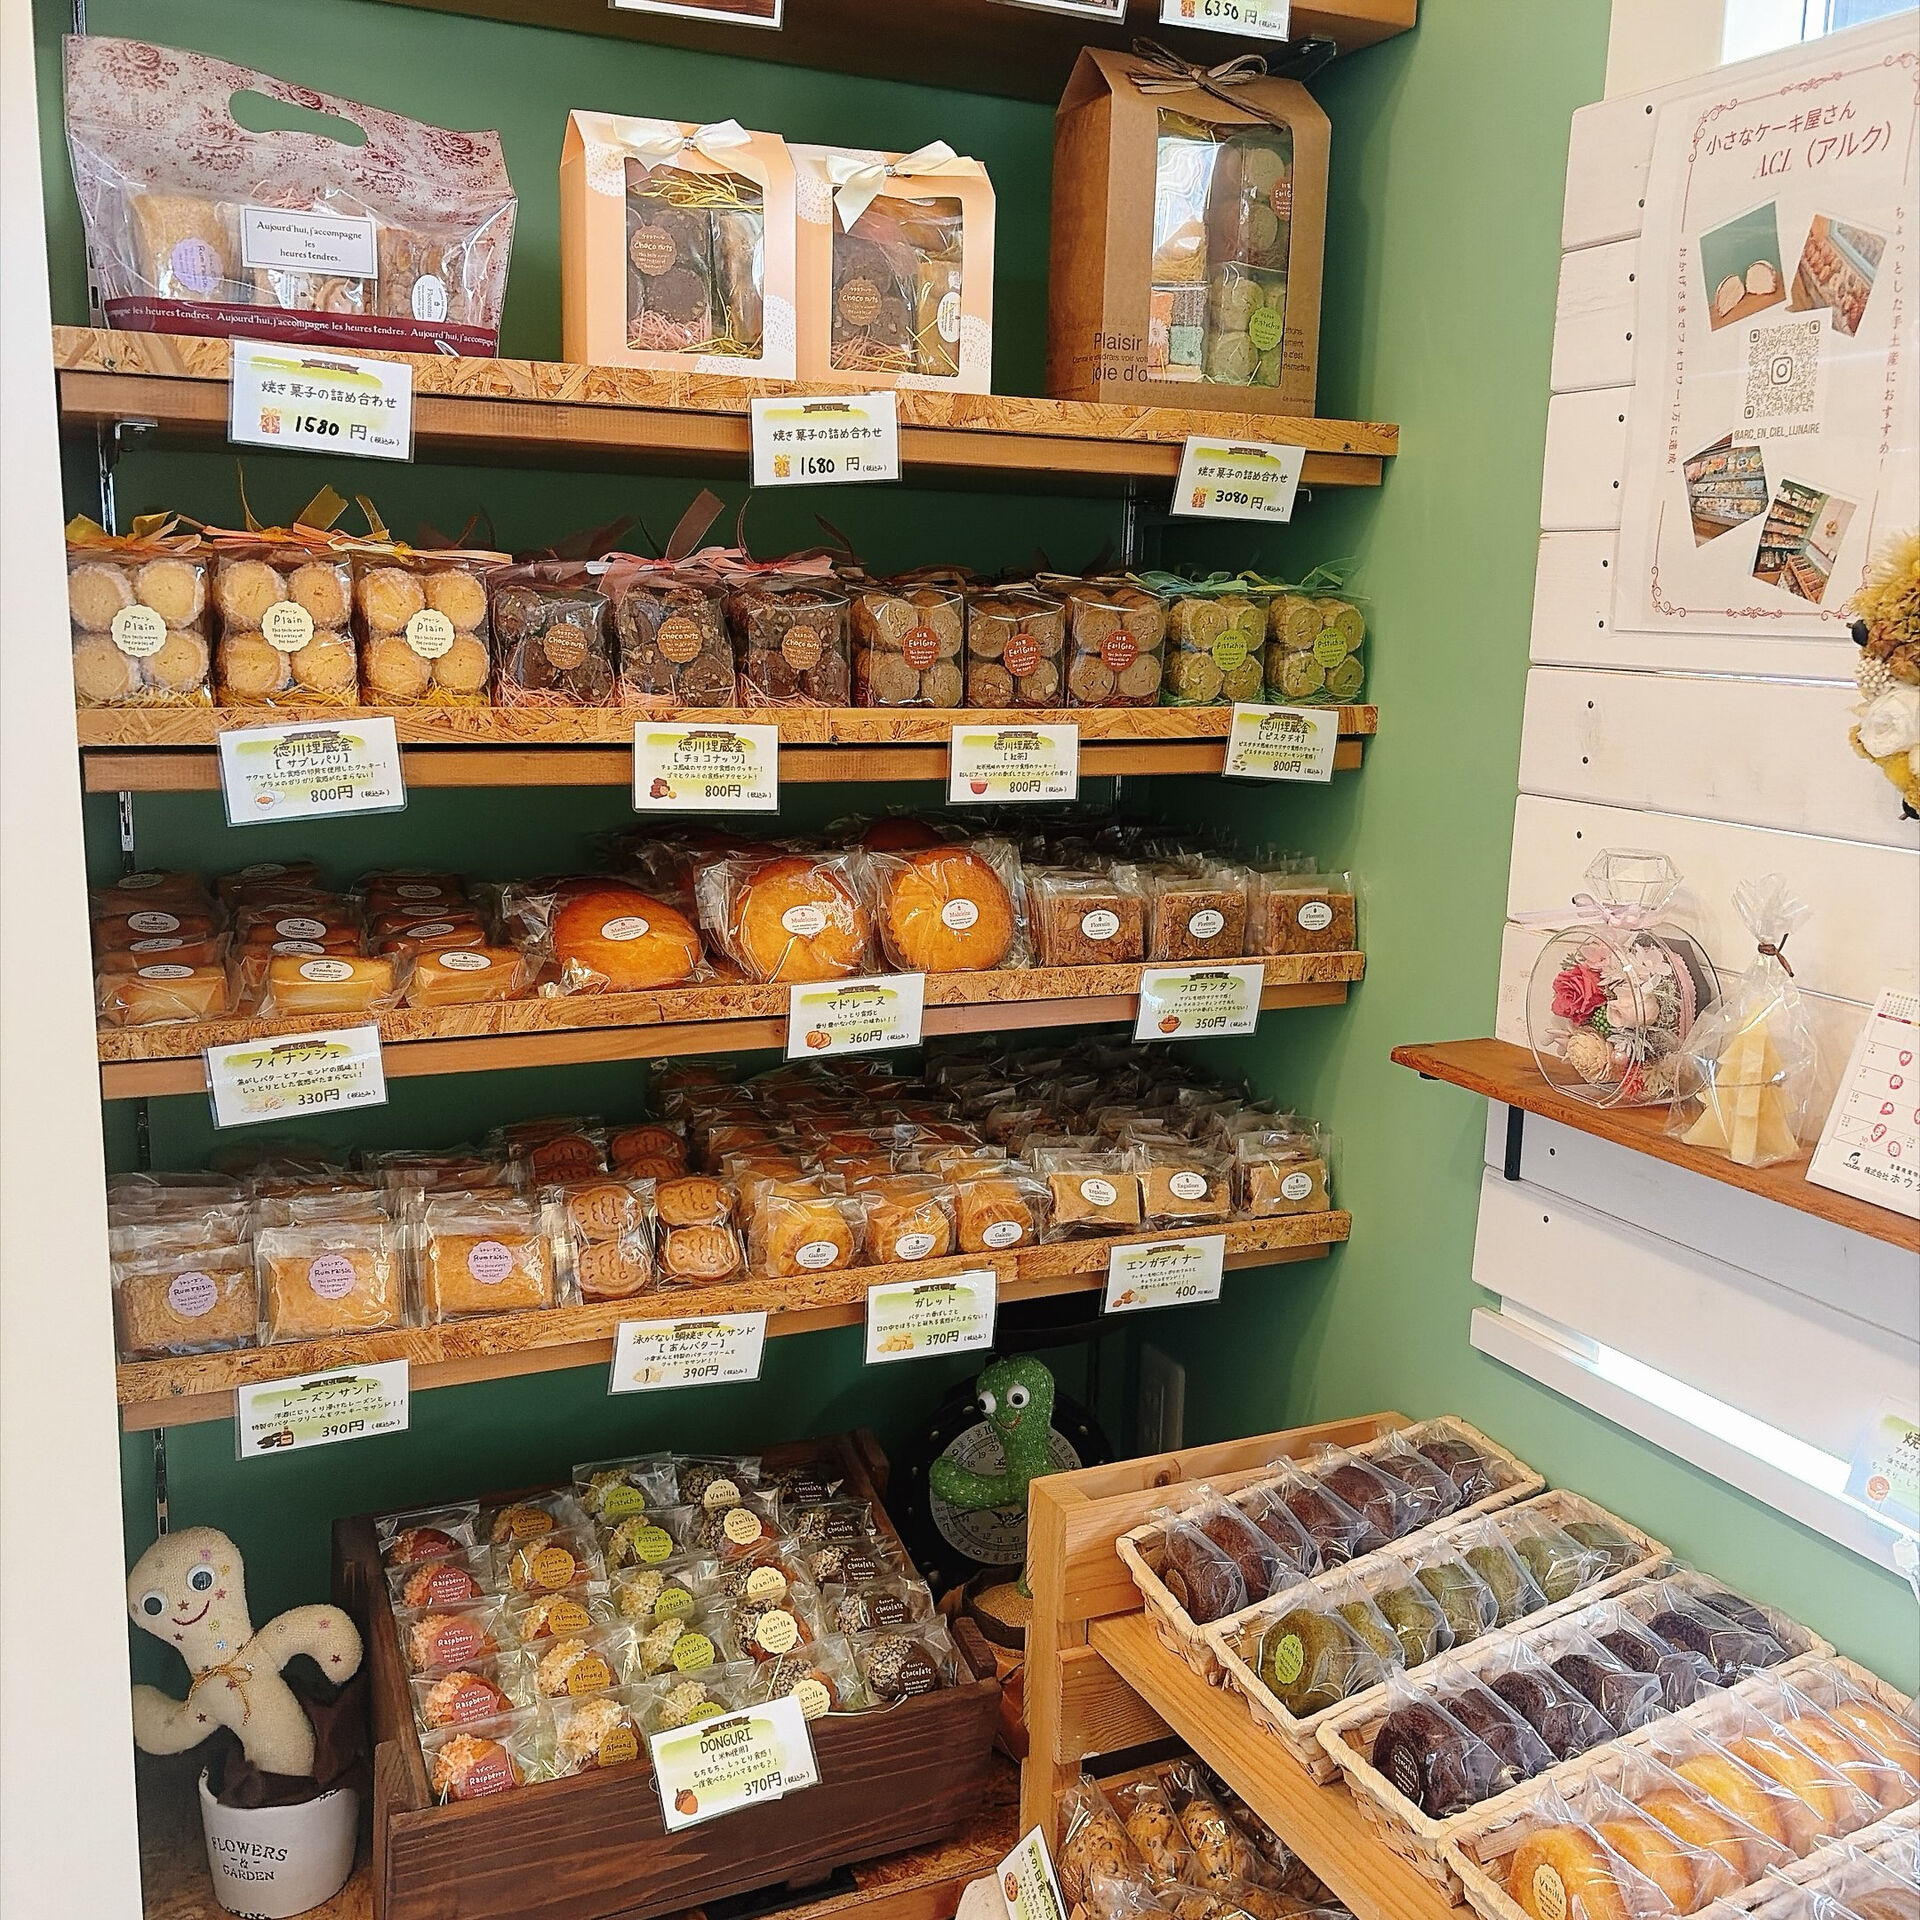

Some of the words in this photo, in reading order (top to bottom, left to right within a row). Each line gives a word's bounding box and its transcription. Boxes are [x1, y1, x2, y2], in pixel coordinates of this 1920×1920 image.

[1204, 0, 1239, 20] 6350
[1244, 9, 1257, 24] 円
[1706, 100, 1856, 156] 小さなケーキ屋さん
[304, 239, 316, 249] les
[280, 249, 307, 260] heures
[308, 252, 342, 263] tendres.
[145, 305, 175, 317] heures
[176, 307, 213, 322] tendres.
[332, 320, 343, 331] les
[345, 321, 372, 333] heures
[373, 324, 407, 337] tendres.
[1093, 332, 1142, 351] Plaisir
[1092, 363, 1118, 385] joie
[260, 380, 398, 409] 焼き菓子の詰め合わせ
[295, 415, 340, 437] 1580
[350, 424, 367, 441] 円
[772, 426, 883, 442] 焼き菓子の詰め合わせ
[1733, 422, 1821, 441] @ARC_EN_CIEL_LUNAIRE
[801, 456, 835, 476] 1680
[846, 456, 860, 472] 円
[1197, 466, 1289, 484] 焼き菓子の詰め合わせ
[1215, 490, 1249, 505] 3080
[1250, 496, 1264, 510] 円
[124, 620, 155, 633] Plain
[273, 613, 303, 626] Plain
[416, 622, 445, 634] Plain
[1260, 718, 1311, 735] 徳川埋蔵金
[993, 739, 1043, 752] 徳川埋蔵金
[1258, 730, 1306, 744] 【ピスタチオ】
[273, 738, 354, 758] 徳川埋蔵金
[678, 739, 747, 754] 徳川埋蔵金
[275, 753, 350, 771] 【サブレパリ】
[673, 753, 746, 764] 【チョコナッツ】
[1272, 760, 1302, 774] 800円
[310, 784, 353, 803] 800円
[705, 784, 742, 799] 800円
[1009, 779, 1042, 794] 800円
[1179, 981, 1238, 994] フロランタン
[826, 995, 886, 1011] マドレーヌ
[1195, 1016, 1227, 1029] 350円
[849, 1029, 883, 1045] 360円
[251, 1049, 341, 1070] フィナンシェ
[298, 1087, 341, 1107] 330円
[1126, 1253, 1202, 1271] エンガディナー
[1175, 1285, 1197, 1298] 400
[914, 1294, 956, 1309] ガレット
[632, 1326, 757, 1346] 泳がない鯛焼きくんサンド
[925, 1330, 960, 1346] 370円
[658, 1338, 726, 1354] 【あんバター】
[682, 1364, 720, 1379] 390円
[282, 1382, 379, 1408] レーズンサンド
[321, 1418, 366, 1438] 390円
[761, 1619, 791, 1636] Vanilla
[900, 1666, 933, 1680] Chocolate
[454, 1692, 492, 1711] Raspberry
[700, 1727, 754, 1754] DONGURI
[468, 1769, 508, 1787] Raspberry
[743, 1771, 783, 1798] 370円
[211, 1836, 288, 1862] FLOWERS
[222, 1865, 275, 1882] GARDEN
